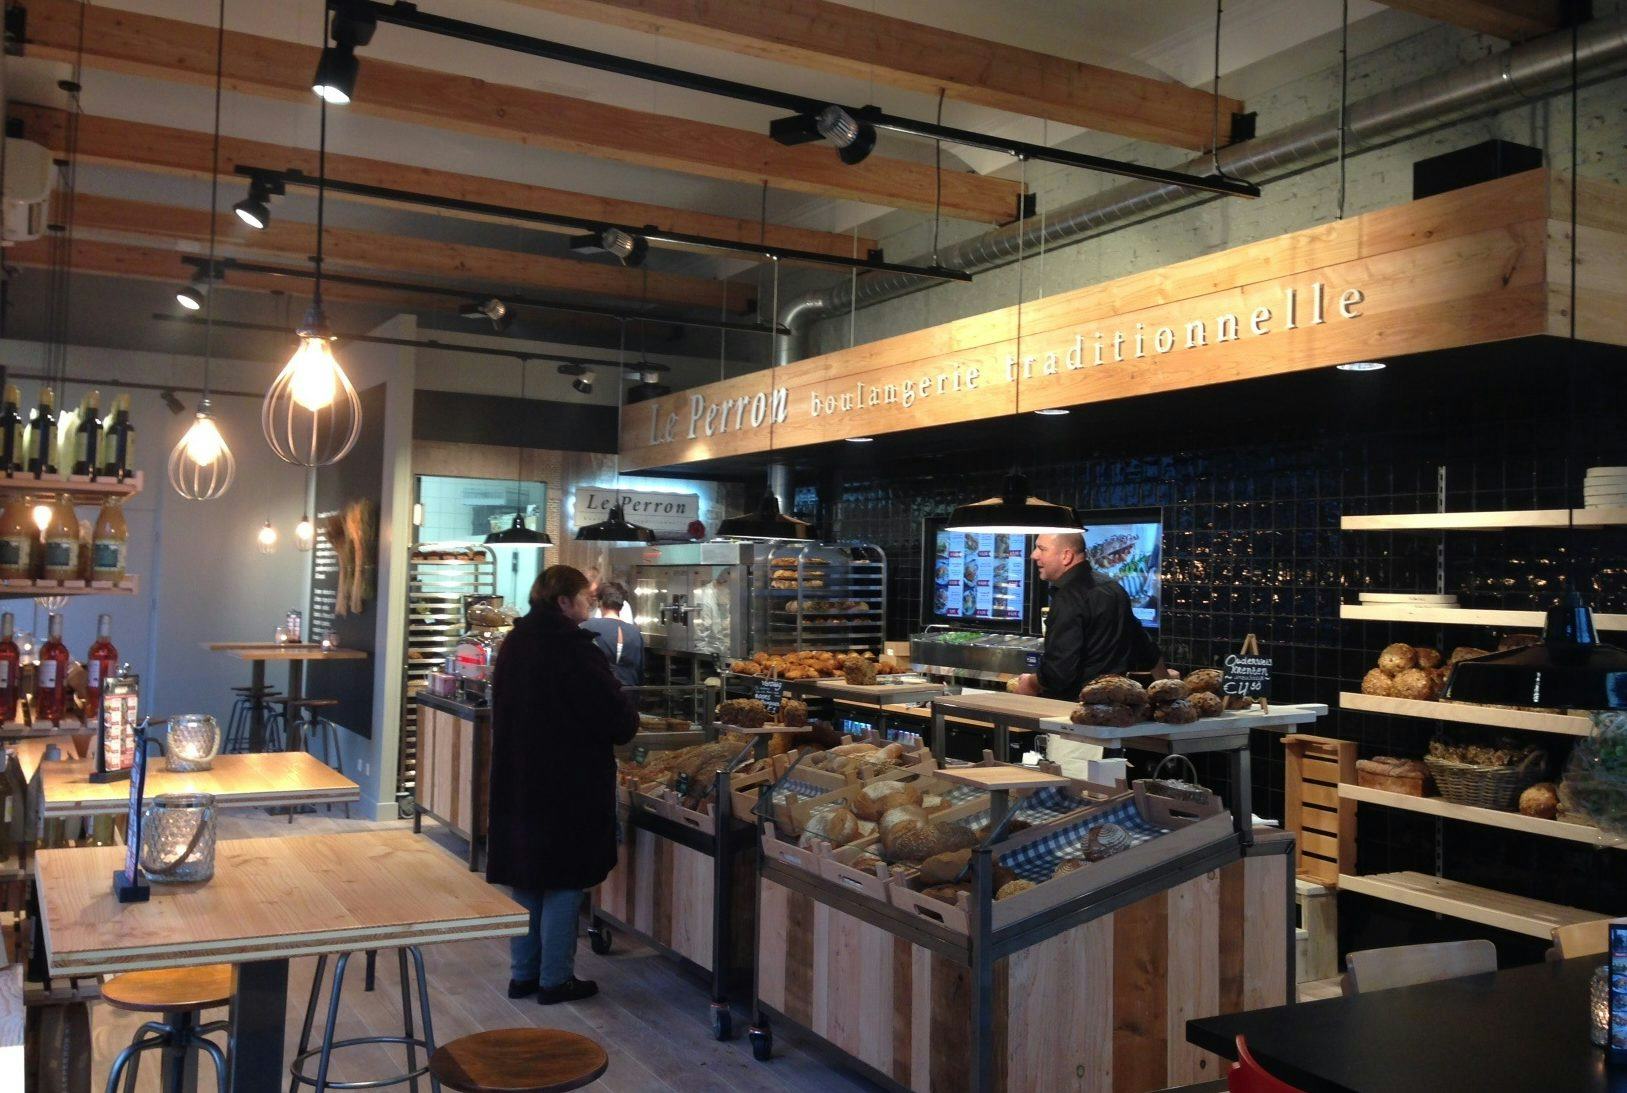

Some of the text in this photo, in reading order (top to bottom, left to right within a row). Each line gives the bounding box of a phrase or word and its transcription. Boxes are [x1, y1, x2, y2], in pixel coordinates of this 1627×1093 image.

[649, 282, 1365, 445] Le Perron boulangerie traditionnelle
[586, 494, 686, 514] Le Perron
